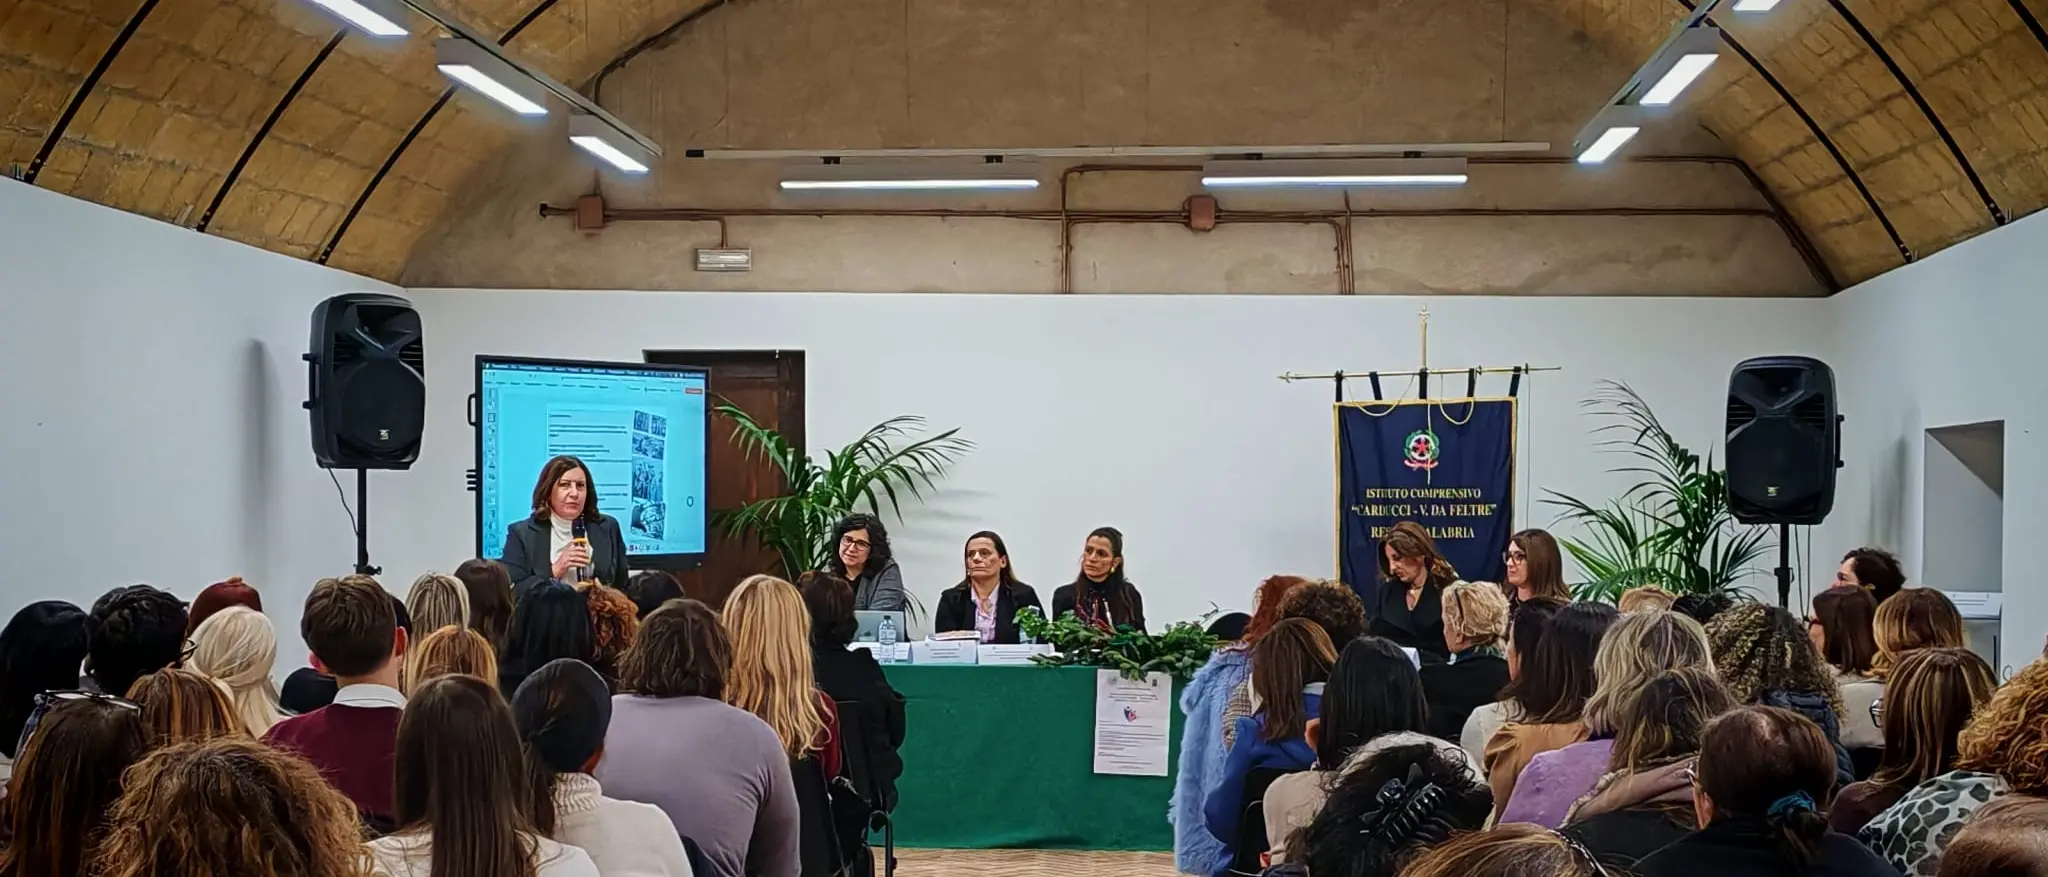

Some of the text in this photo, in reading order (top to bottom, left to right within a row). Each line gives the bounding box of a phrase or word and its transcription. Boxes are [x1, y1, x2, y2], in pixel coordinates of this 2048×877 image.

[1410, 488, 1481, 498] COMPRENSIVO
[1431, 505, 1447, 516] DA
[1426, 526, 1475, 538] ALABRIA
